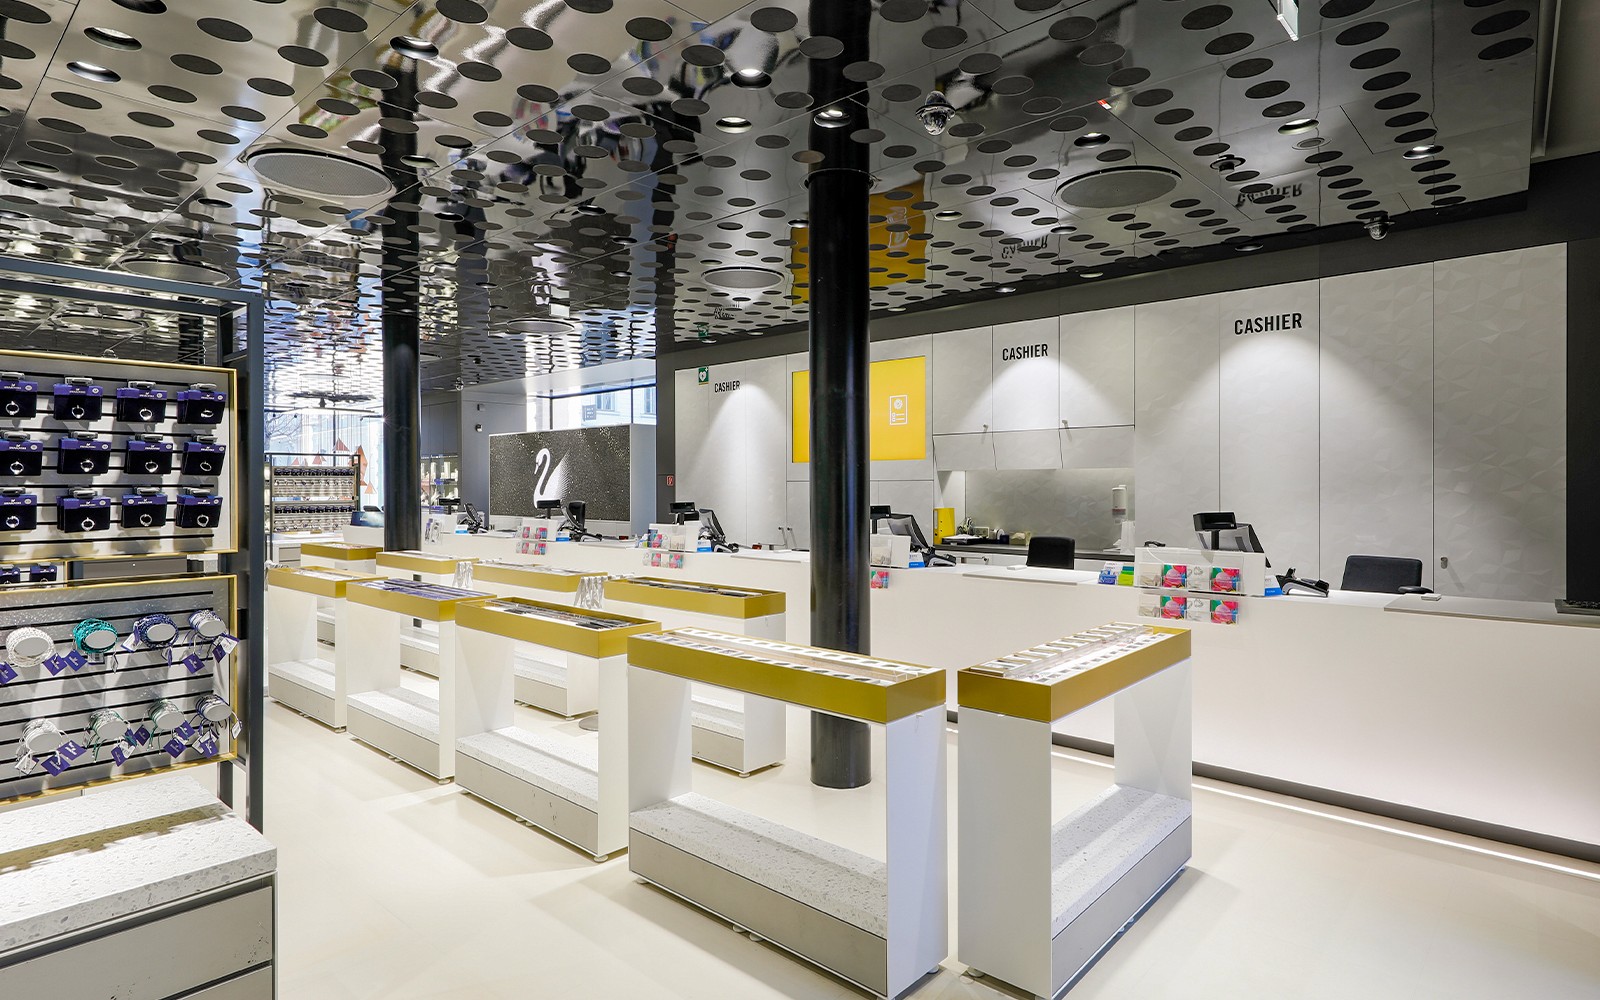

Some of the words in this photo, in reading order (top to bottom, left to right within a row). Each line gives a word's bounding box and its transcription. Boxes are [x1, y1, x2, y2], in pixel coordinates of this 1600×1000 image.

[1234, 312, 1303, 335] CASHIER
[1002, 343, 1048, 361] CASHIER
[714, 380, 741, 393] CASHIER
